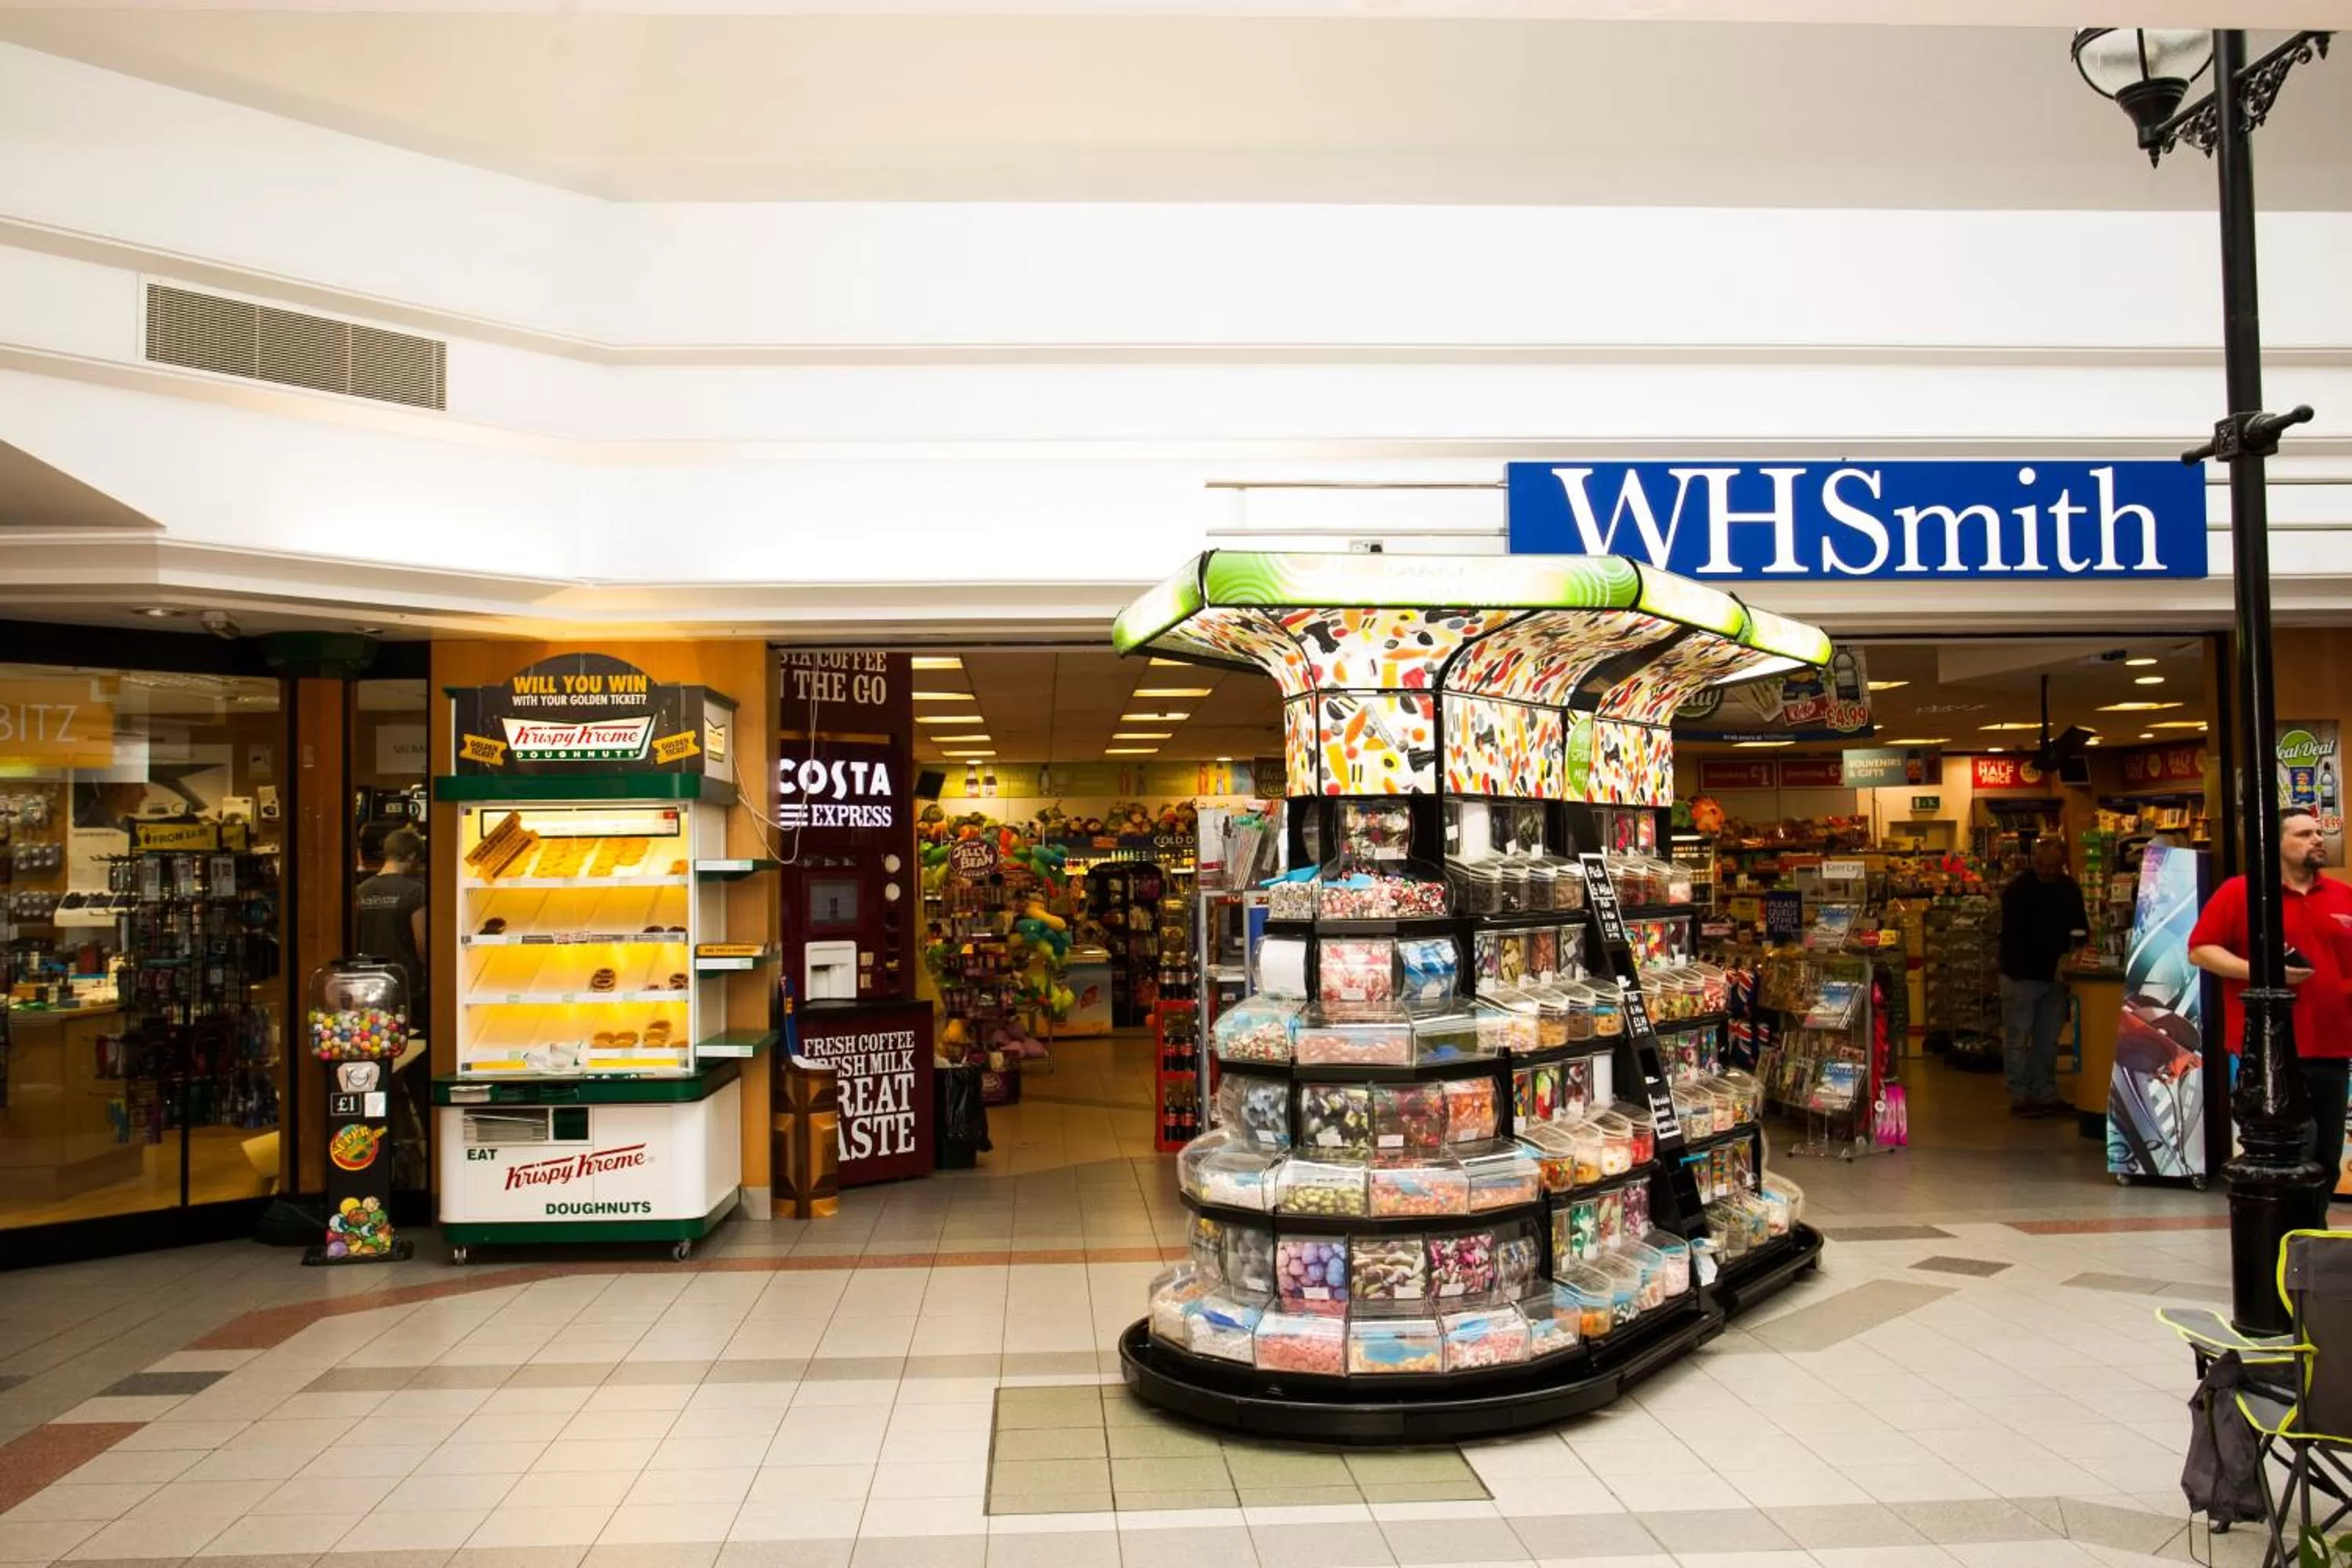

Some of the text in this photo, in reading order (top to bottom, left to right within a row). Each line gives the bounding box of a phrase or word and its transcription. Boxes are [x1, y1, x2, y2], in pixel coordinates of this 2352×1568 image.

[1552, 466, 2167, 575] WHSmith
[514, 675, 647, 694] WILL YOU WIN
[793, 669, 846, 702] THE
[853, 673, 887, 705] GO
[512, 694, 647, 706] WITH YOUR GOLDEN TICKET?
[514, 725, 641, 748] Krispy Kreme
[516, 750, 636, 759] DOUGHNUTS
[2302, 739, 2335, 757] Deal
[1848, 757, 1901, 768] SOUVENIRS
[1979, 764, 2014, 777] HALF
[780, 758, 891, 800] COSTA
[1860, 768, 1886, 778] GIFTS
[1982, 775, 2012, 785] PRICE
[811, 804, 892, 827] EXPRESS
[1153, 834, 1185, 848] COLD
[803, 1031, 915, 1058] FRESH COFFEE
[869, 1050, 915, 1075] MILK
[339, 1095, 355, 1112] £1
[837, 1073, 915, 1118] REAT
[837, 1112, 915, 1162] ASTE
[467, 1149, 498, 1160] EAT
[504, 1143, 646, 1191] Krispy Kreme
[546, 1201, 652, 1215] DOUGHNUTS
